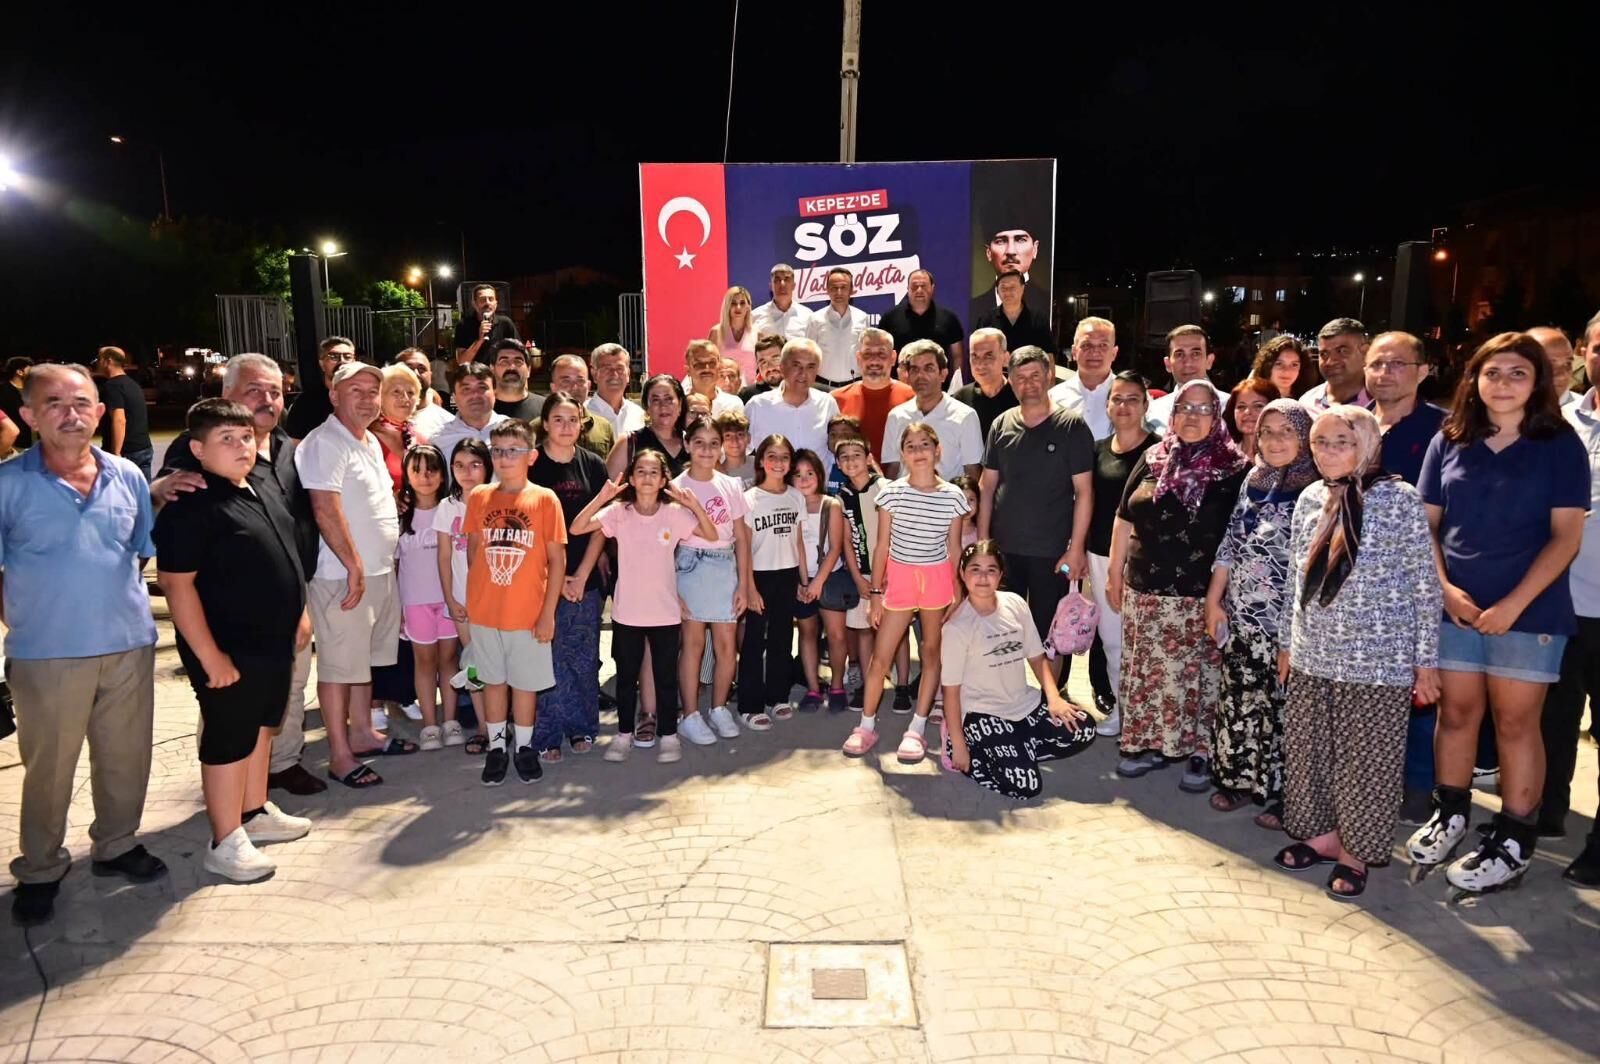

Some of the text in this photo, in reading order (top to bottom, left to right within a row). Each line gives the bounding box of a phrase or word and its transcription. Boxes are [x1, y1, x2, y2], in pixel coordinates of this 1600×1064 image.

[806, 193, 881, 213] KEPEZ'DE
[794, 213, 902, 261] SÖZ
[797, 262, 906, 299] Vatdaşta
[506, 528, 535, 548] HARD
